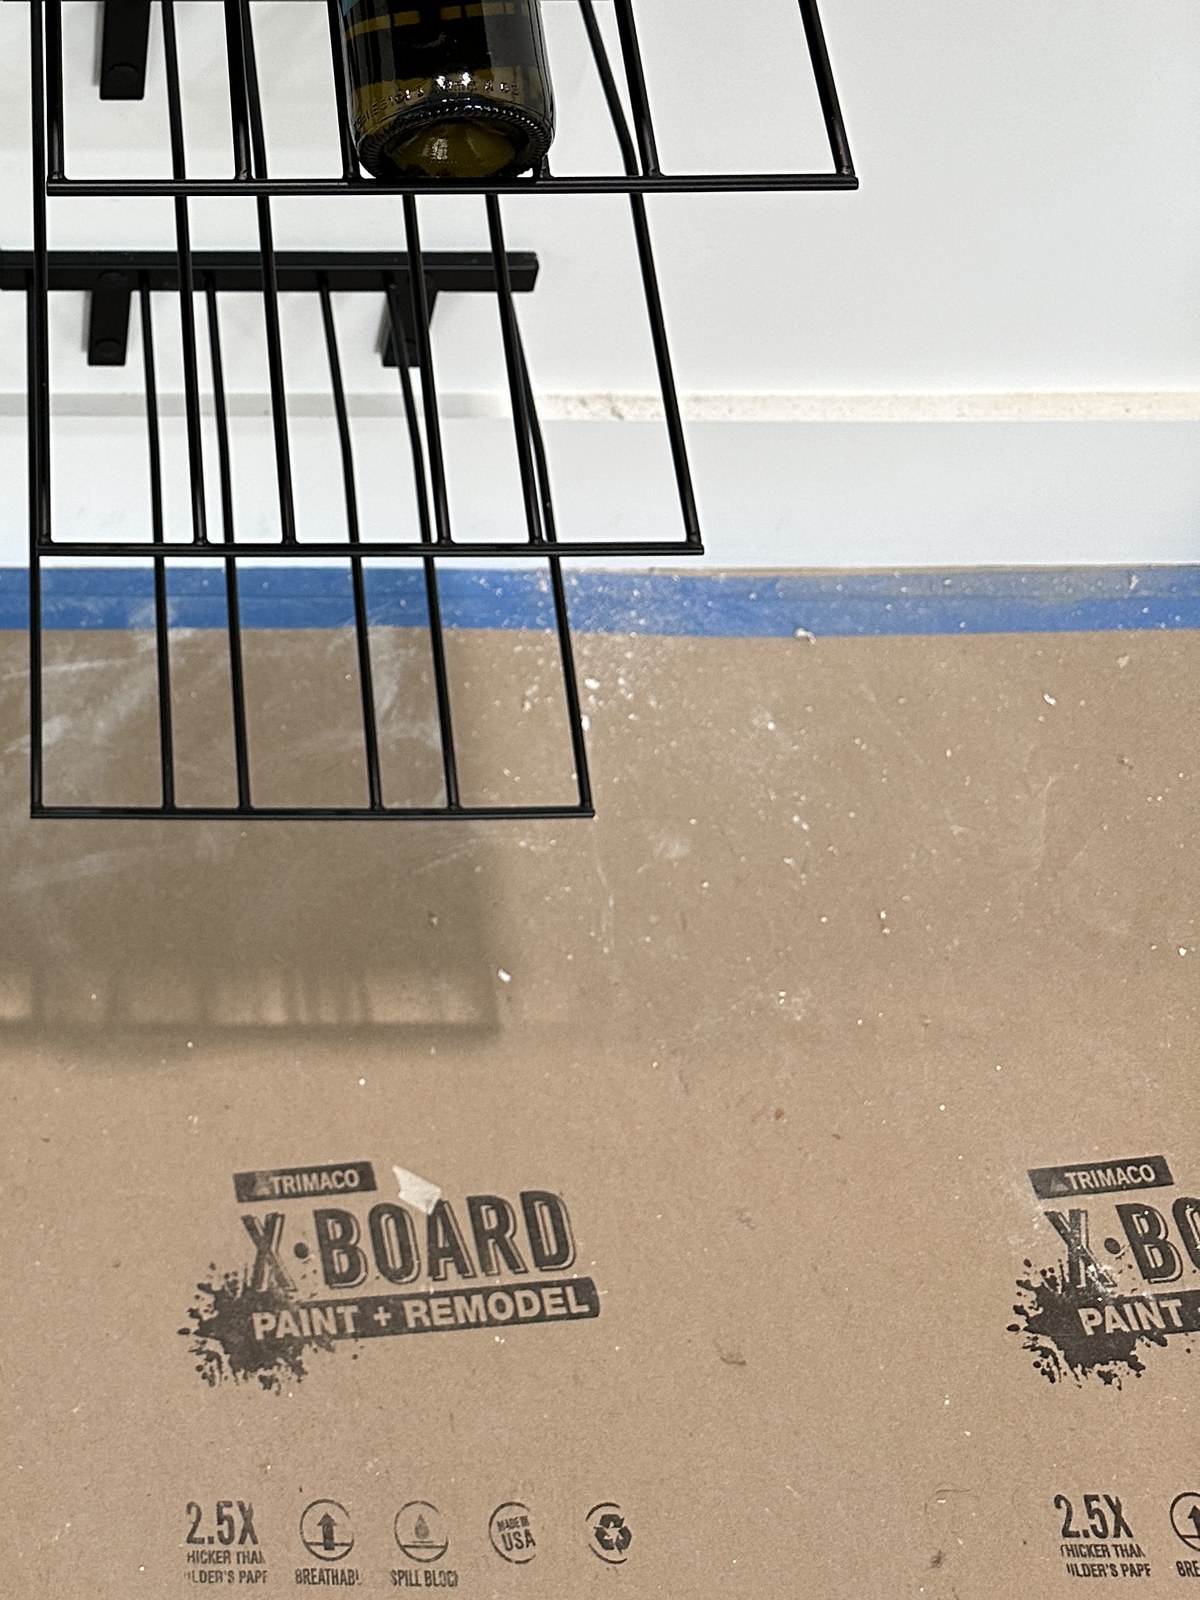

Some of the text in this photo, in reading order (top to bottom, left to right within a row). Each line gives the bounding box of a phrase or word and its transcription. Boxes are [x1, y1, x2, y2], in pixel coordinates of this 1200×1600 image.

[270, 1169, 360, 1195] TRIMACO
[1065, 1164, 1156, 1191] TRIMACO
[252, 1306, 358, 1340] PAINT
[402, 1286, 590, 1328] REMODEL
[1078, 1299, 1183, 1336] PAINT
[186, 1500, 258, 1545] 2.5X
[1054, 1494, 1133, 1538] 2.5X
[501, 1529, 536, 1551] USA
